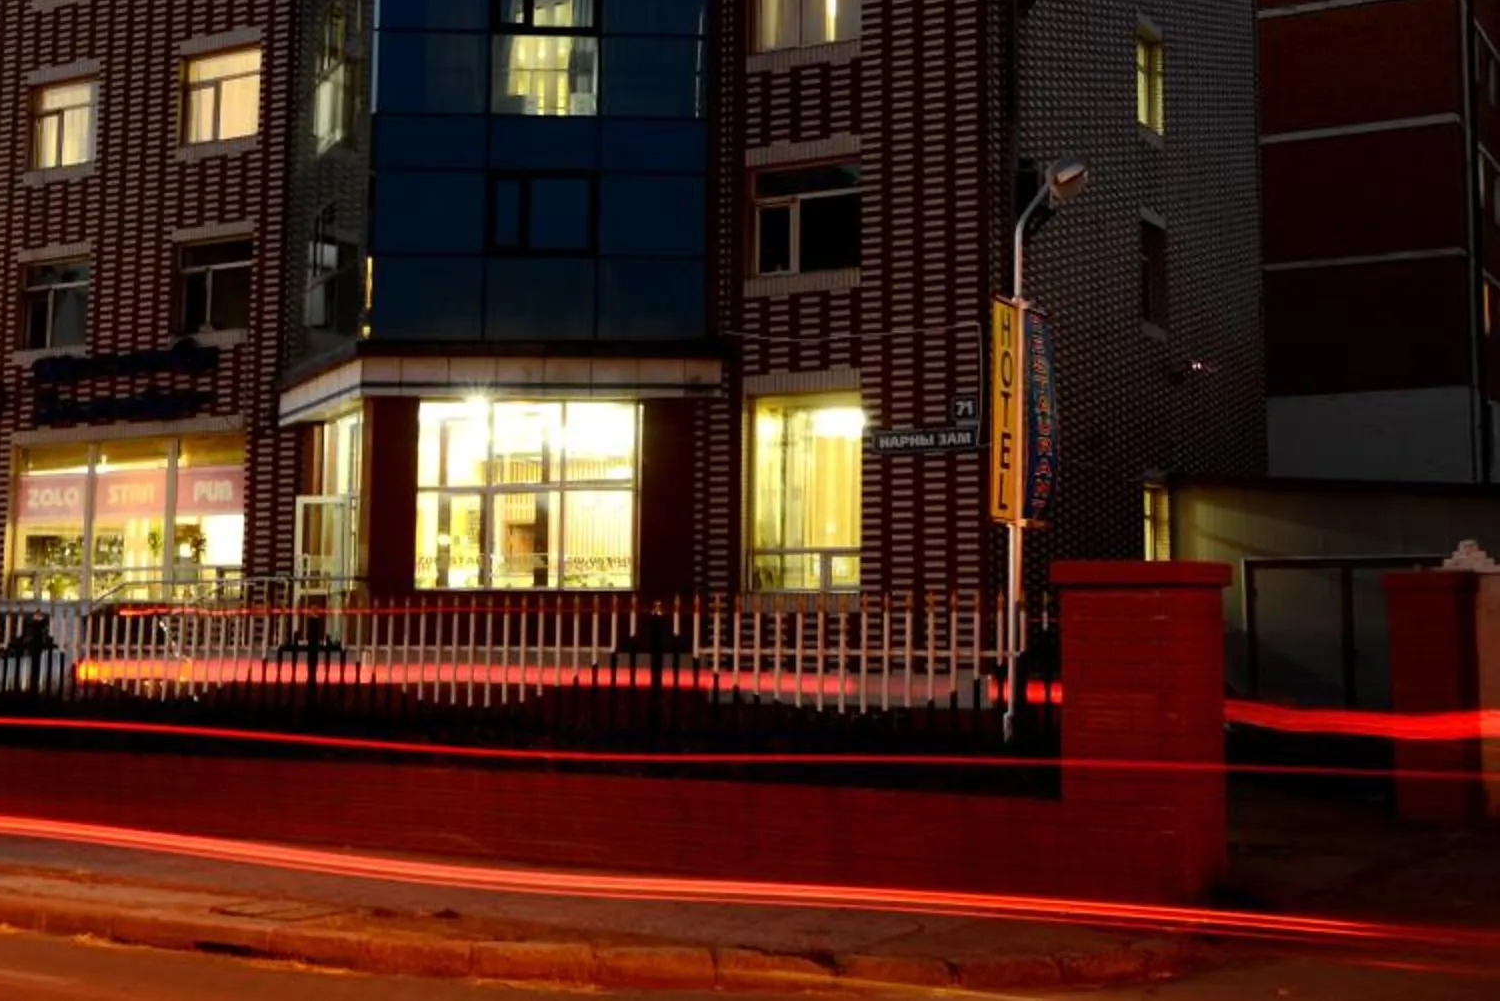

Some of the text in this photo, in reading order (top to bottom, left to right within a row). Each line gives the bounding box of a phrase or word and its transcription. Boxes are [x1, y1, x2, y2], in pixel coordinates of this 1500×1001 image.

[955, 400, 973, 417] 71
[998, 308, 1013, 509] HOTEL
[879, 432, 972, 449] НАРНЫ ЗАМ
[26, 487, 78, 508] ZOLO
